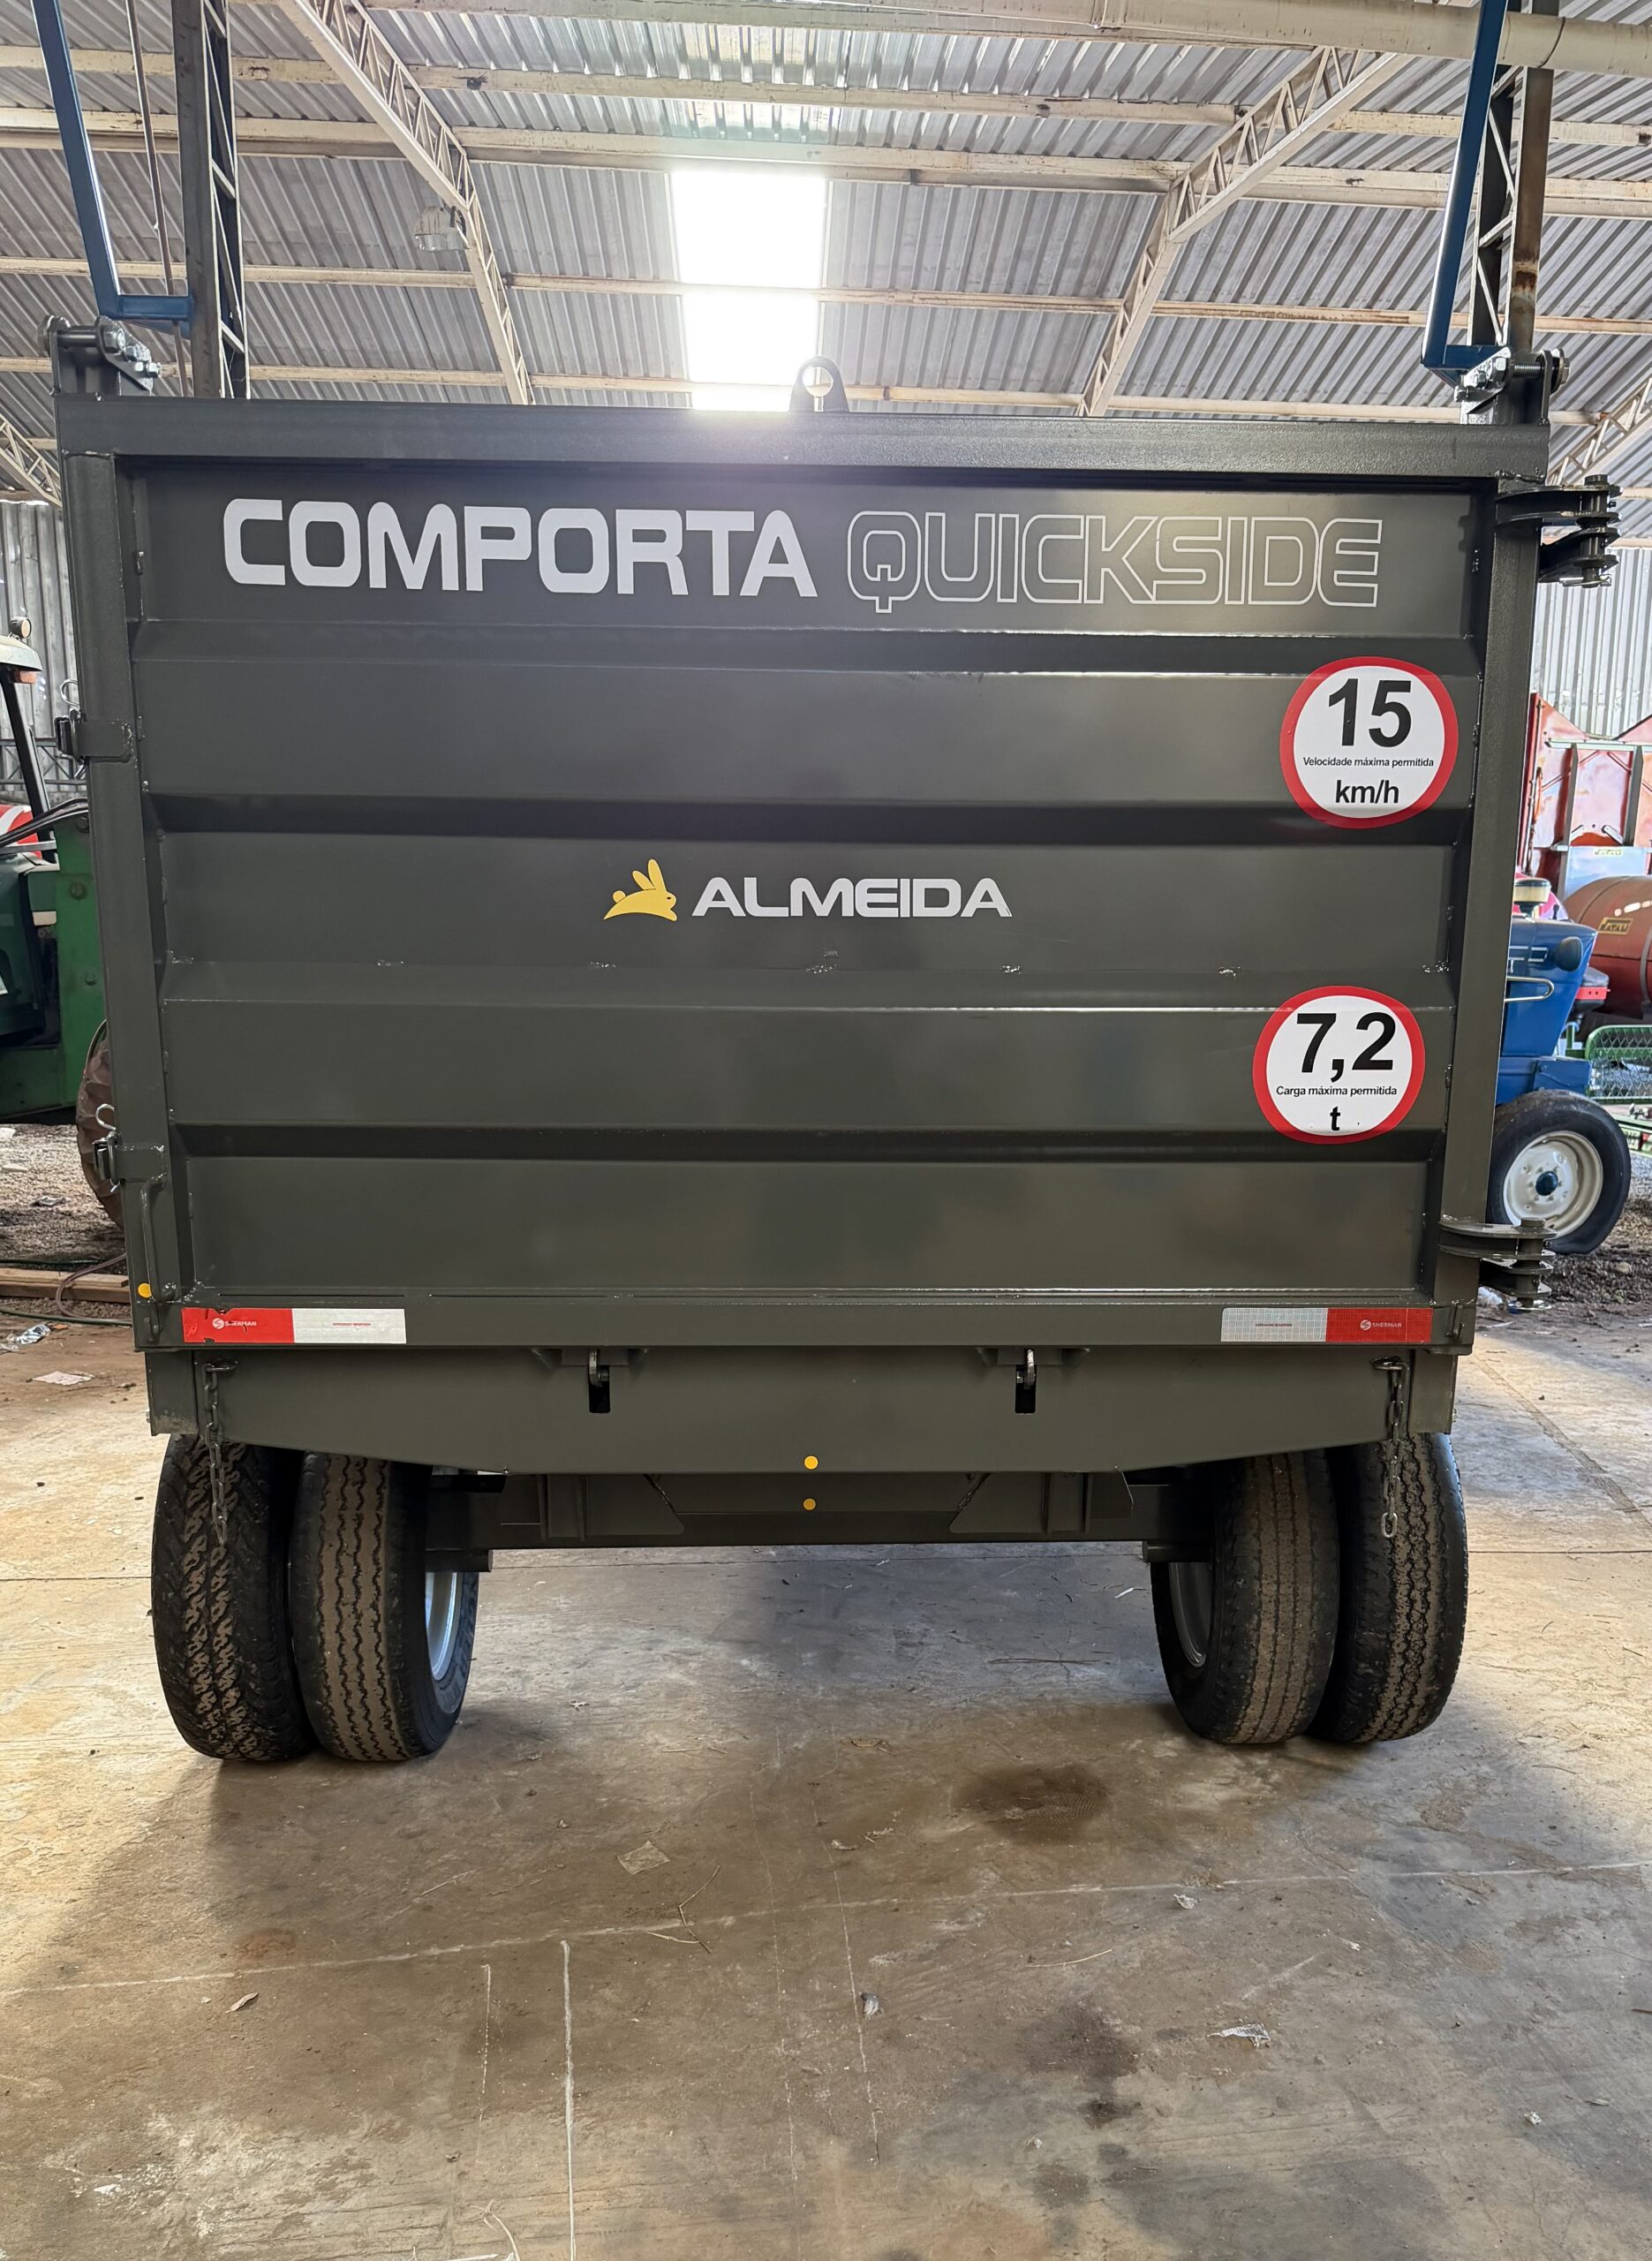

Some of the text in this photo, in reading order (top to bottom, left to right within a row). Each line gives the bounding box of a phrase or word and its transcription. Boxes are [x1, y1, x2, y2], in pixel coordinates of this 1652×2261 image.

[223, 498, 1383, 613] COMPORTA QUICKSIDE
[1329, 678, 1412, 747] 15
[1303, 757, 1434, 768] Velocidade máxima permitida
[1335, 779, 1399, 804] km/h
[691, 876, 1013, 918] ALMEIDA
[1296, 1012, 1396, 1083] 7,2
[1276, 1085, 1398, 1097] Carga máxima permitida
[1330, 1106, 1341, 1131] t
